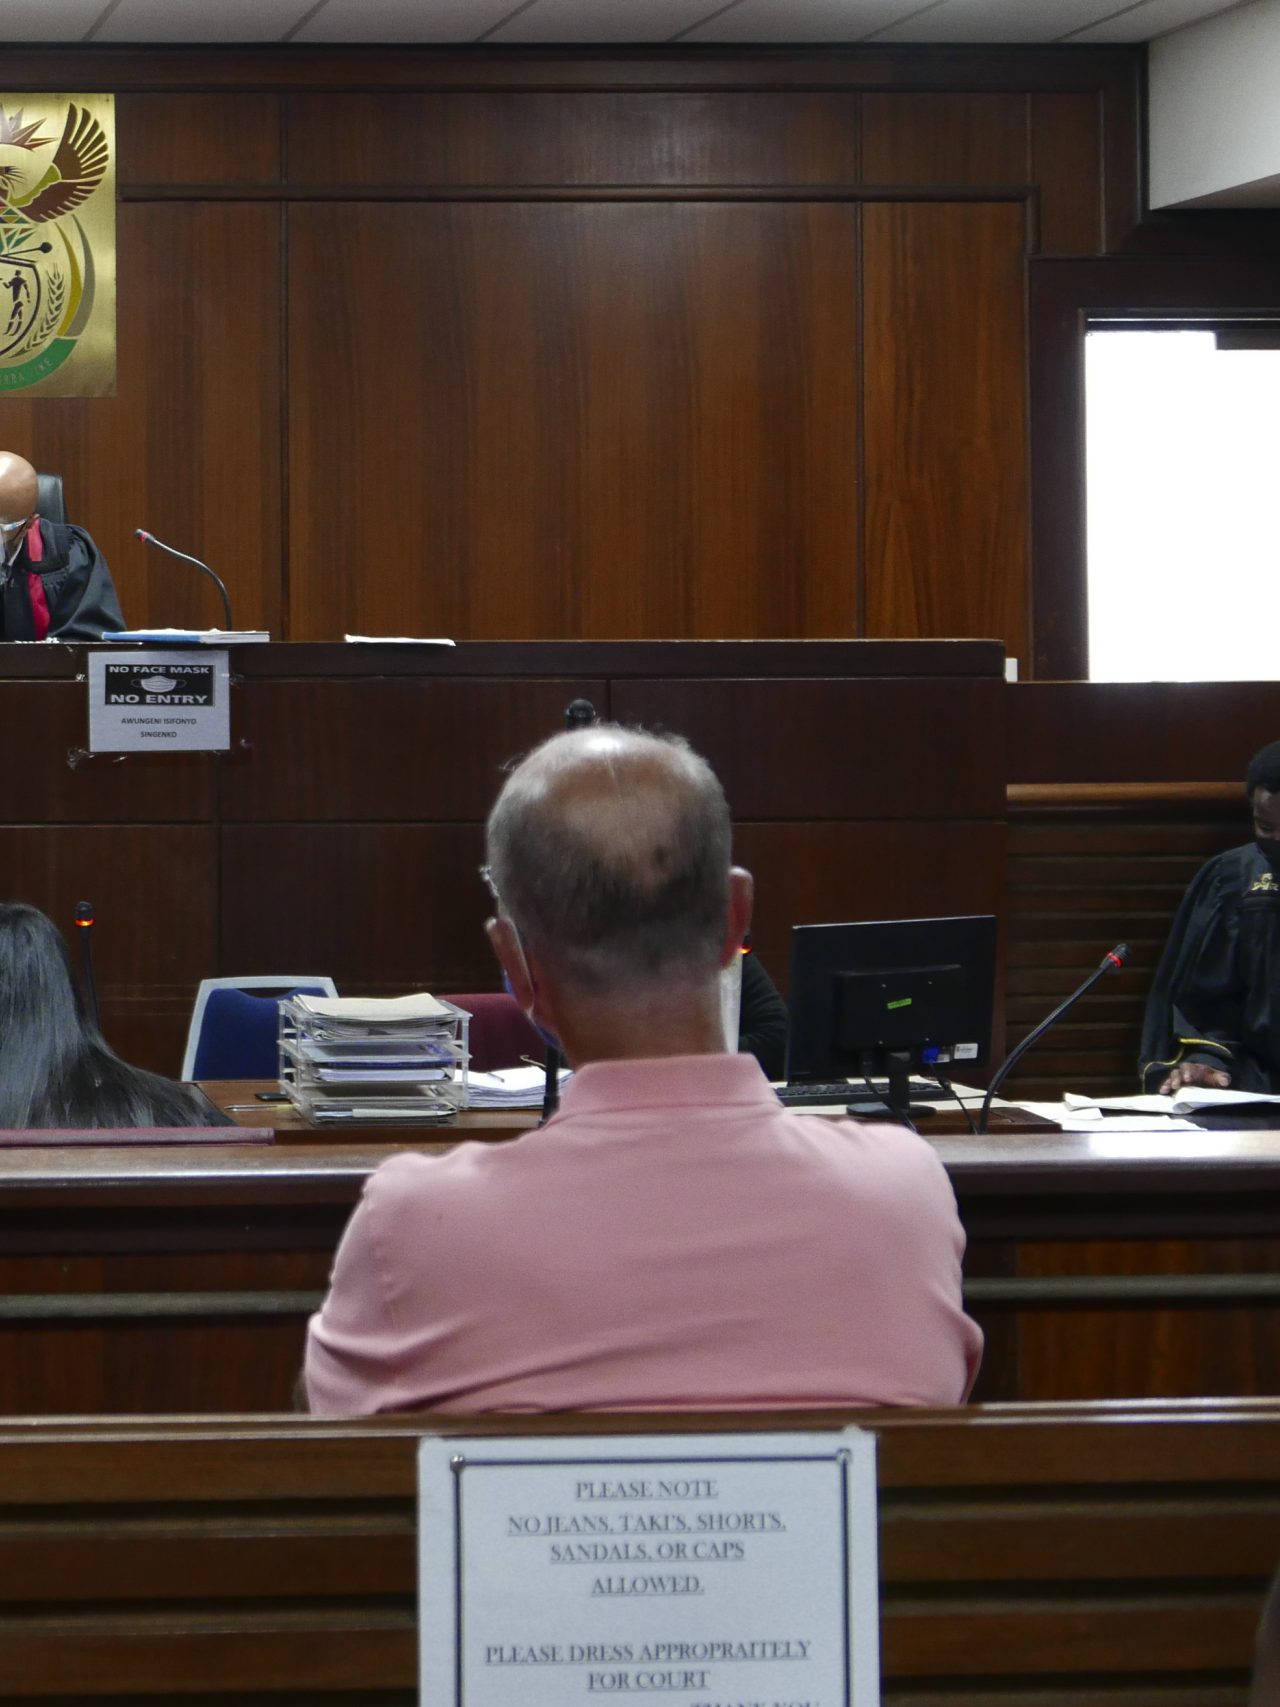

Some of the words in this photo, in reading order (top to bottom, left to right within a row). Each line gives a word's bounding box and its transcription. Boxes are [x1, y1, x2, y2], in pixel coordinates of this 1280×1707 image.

[109, 666, 130, 674] NO
[132, 666, 167, 674] FACE
[110, 694, 140, 704] NO
[145, 694, 209, 704] ENTRY
[575, 1481, 653, 1499] PLEASE
[658, 1480, 719, 1498] NOTE
[507, 1516, 540, 1534] NO
[657, 1542, 686, 1560] OR
[693, 1542, 746, 1560] CAPS
[486, 1645, 564, 1664] PLEASE
[569, 1644, 635, 1662] DRESS
[588, 1672, 631, 1690] FOR
[636, 1670, 711, 1689] COURT
